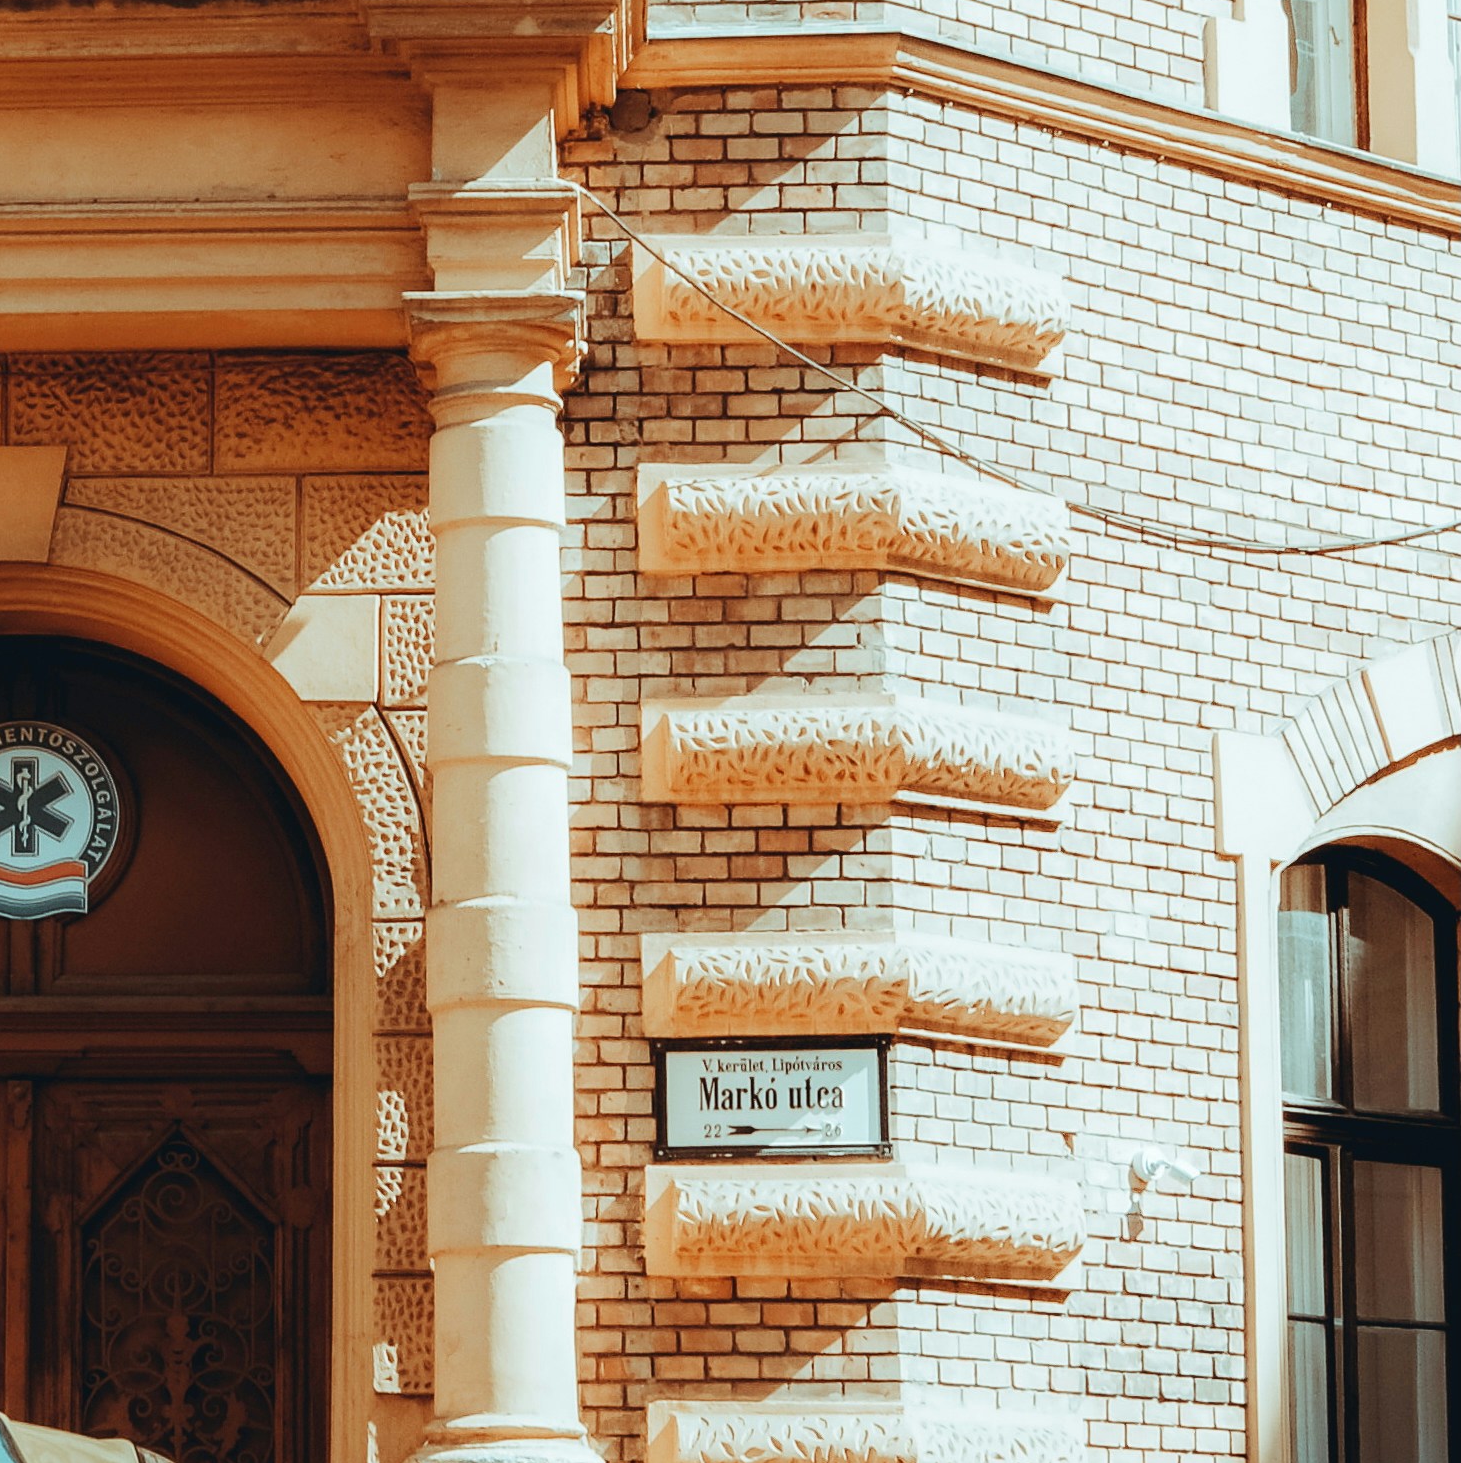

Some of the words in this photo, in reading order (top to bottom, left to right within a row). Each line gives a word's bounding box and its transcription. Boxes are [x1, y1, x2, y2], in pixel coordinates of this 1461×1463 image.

[702, 1059, 713, 1073] V.
[718, 1058, 769, 1074] kerület,
[772, 1056, 843, 1075] Lipótváros
[699, 1076, 778, 1112] Markó
[789, 1076, 844, 1109] utca
[704, 1123, 722, 1138] 22
